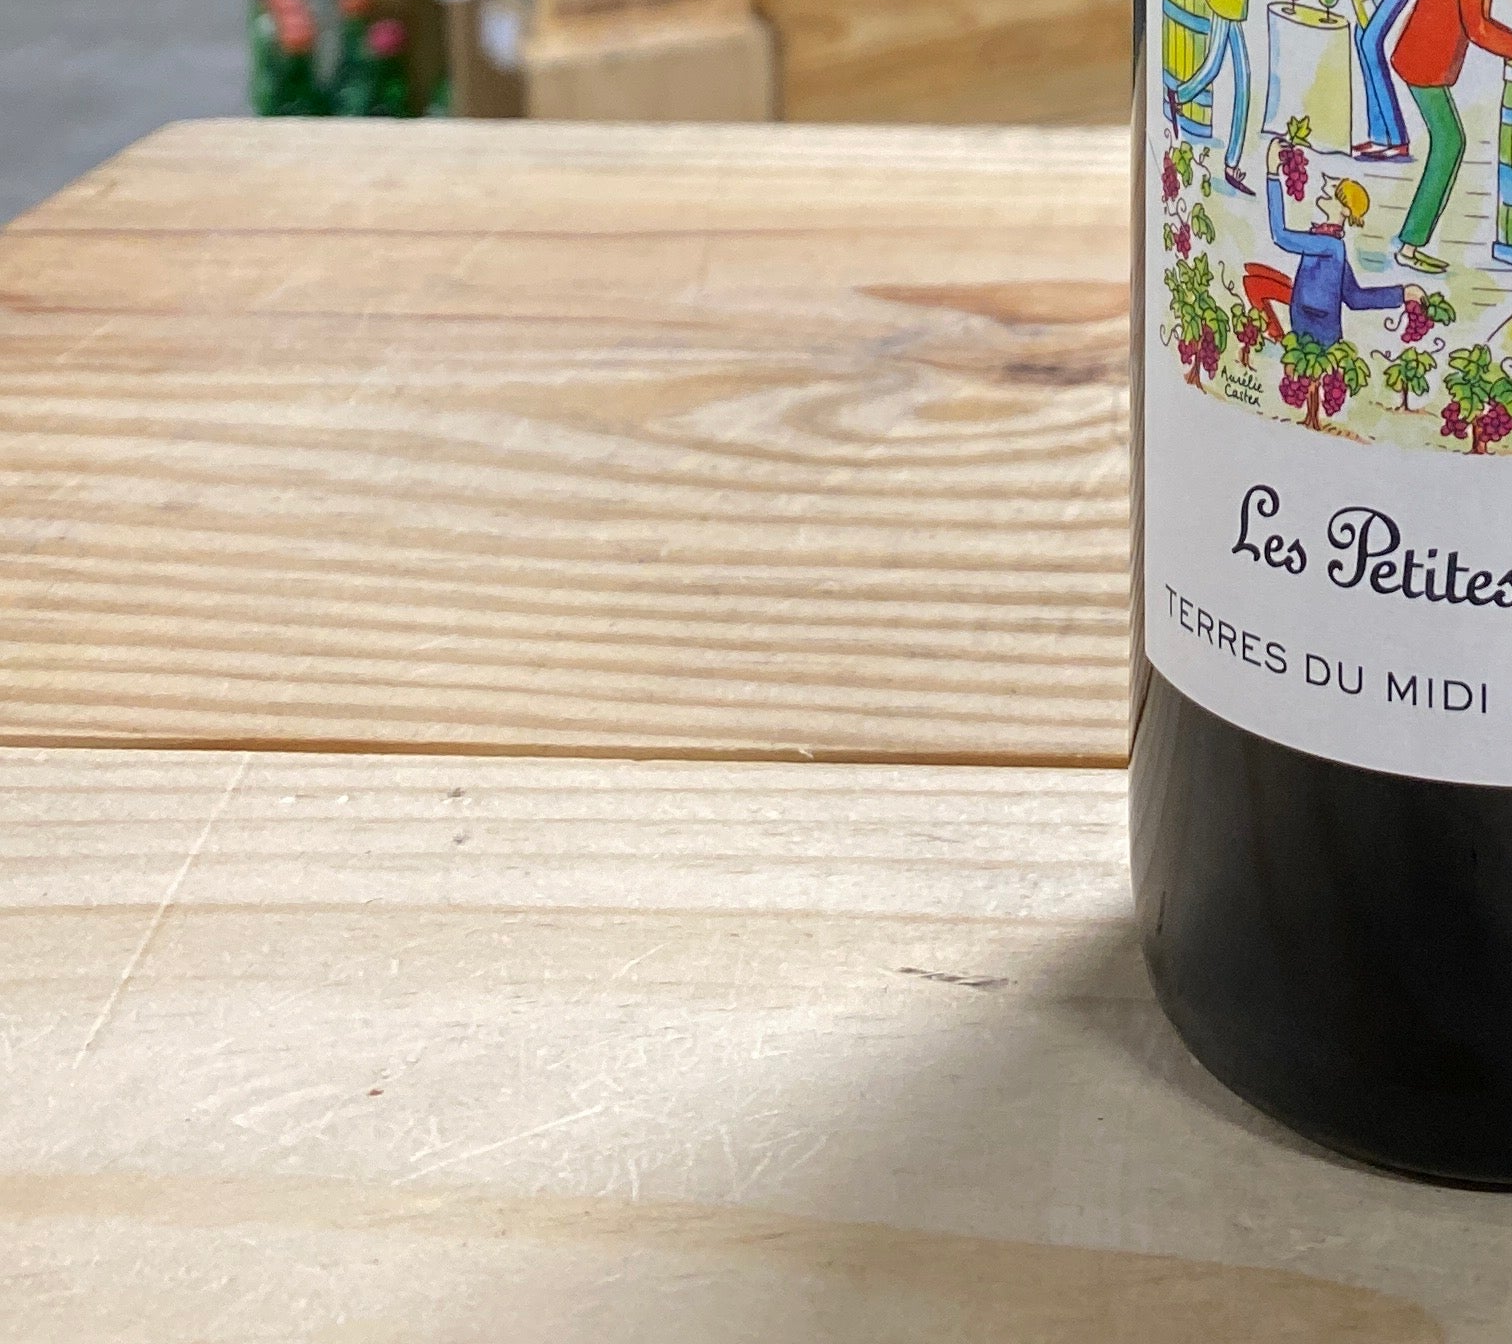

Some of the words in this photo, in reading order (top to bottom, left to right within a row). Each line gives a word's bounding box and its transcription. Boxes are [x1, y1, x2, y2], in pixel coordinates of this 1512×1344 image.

[1232, 483, 1308, 575] Les
[1164, 584, 1288, 675] TERRES
[1304, 653, 1364, 696] DU
[1386, 671, 1488, 714] MIDI
